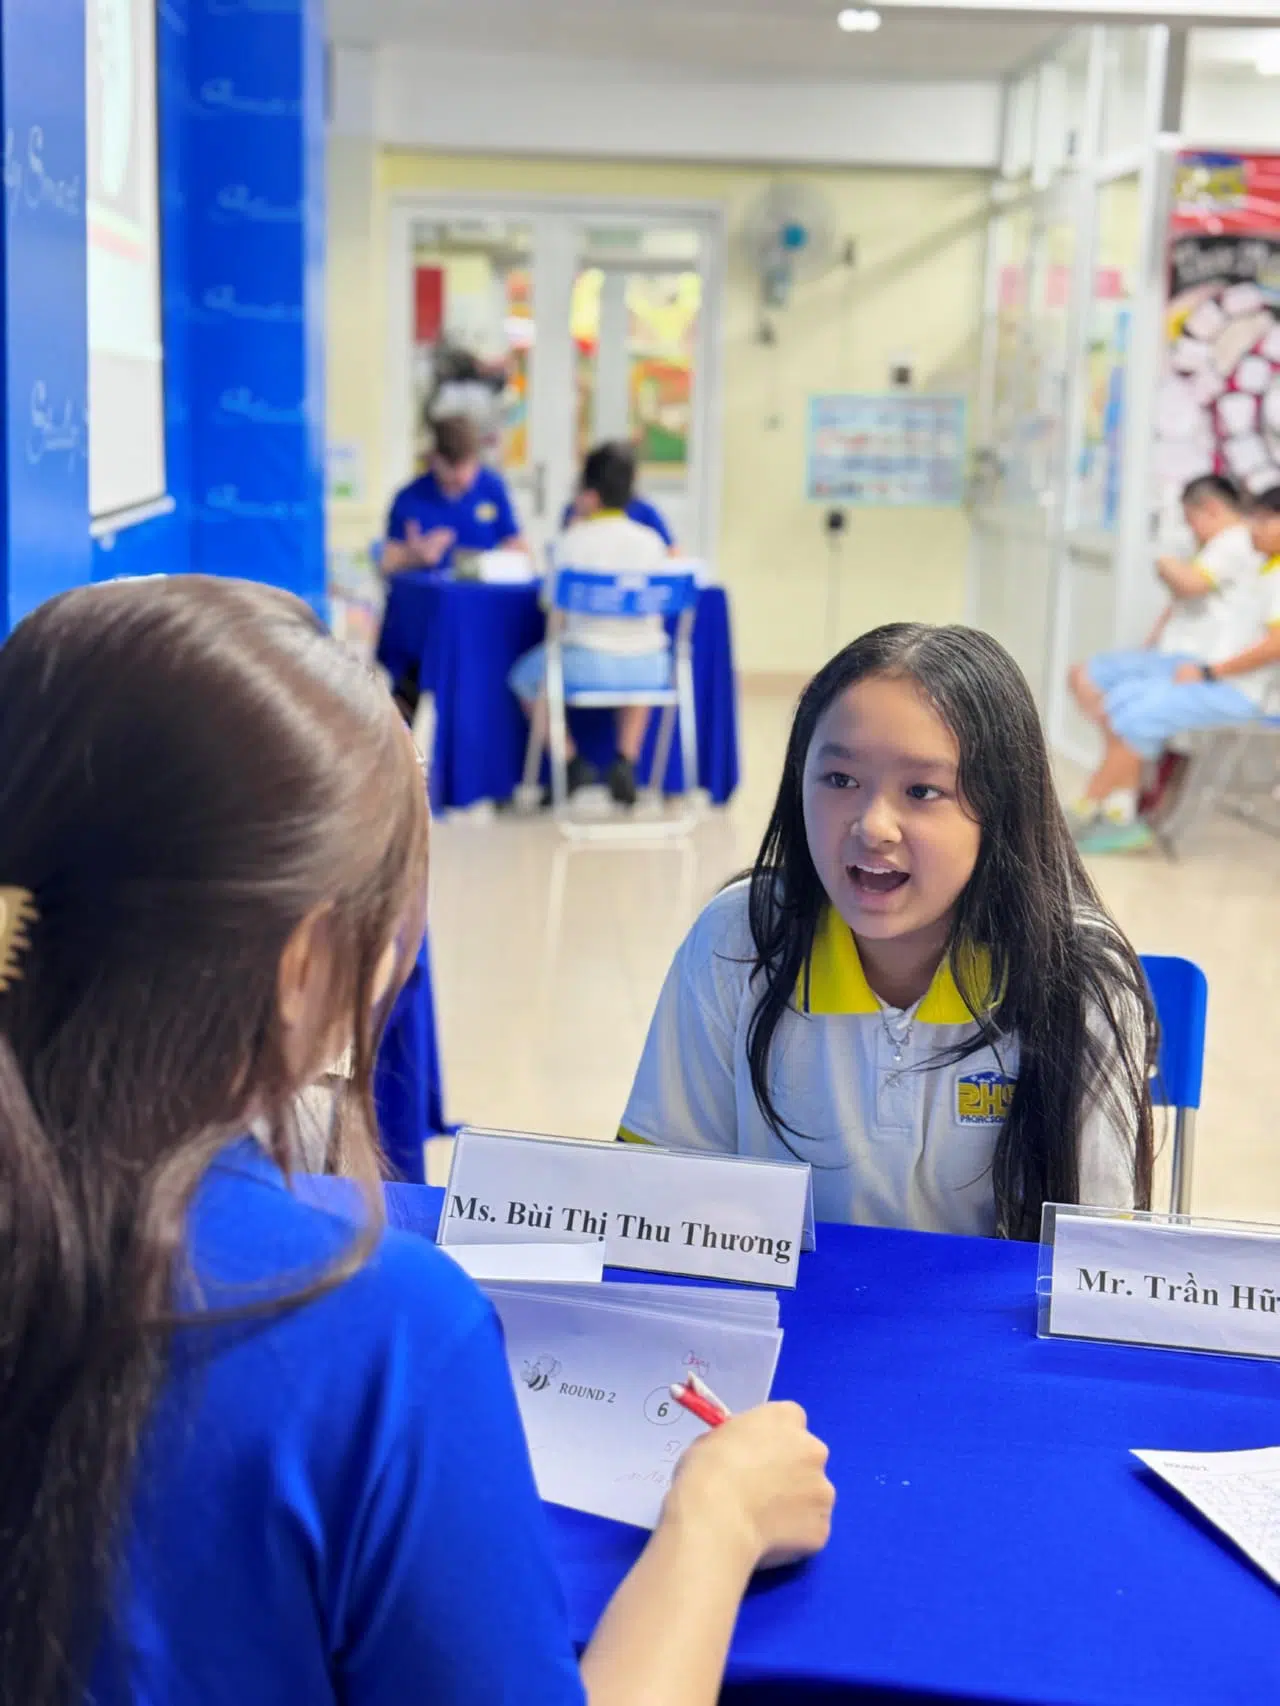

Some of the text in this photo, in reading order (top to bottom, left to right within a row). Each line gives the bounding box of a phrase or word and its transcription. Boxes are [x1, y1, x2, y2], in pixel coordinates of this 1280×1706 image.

[448, 1195, 792, 1264] Ms. Bùi Thị Thu Thương
[1076, 1267, 1132, 1296] Mr.
[1144, 1271, 1219, 1306] Trần
[560, 1382, 617, 1404] ROUND 2
[657, 1401, 670, 1418] 6
